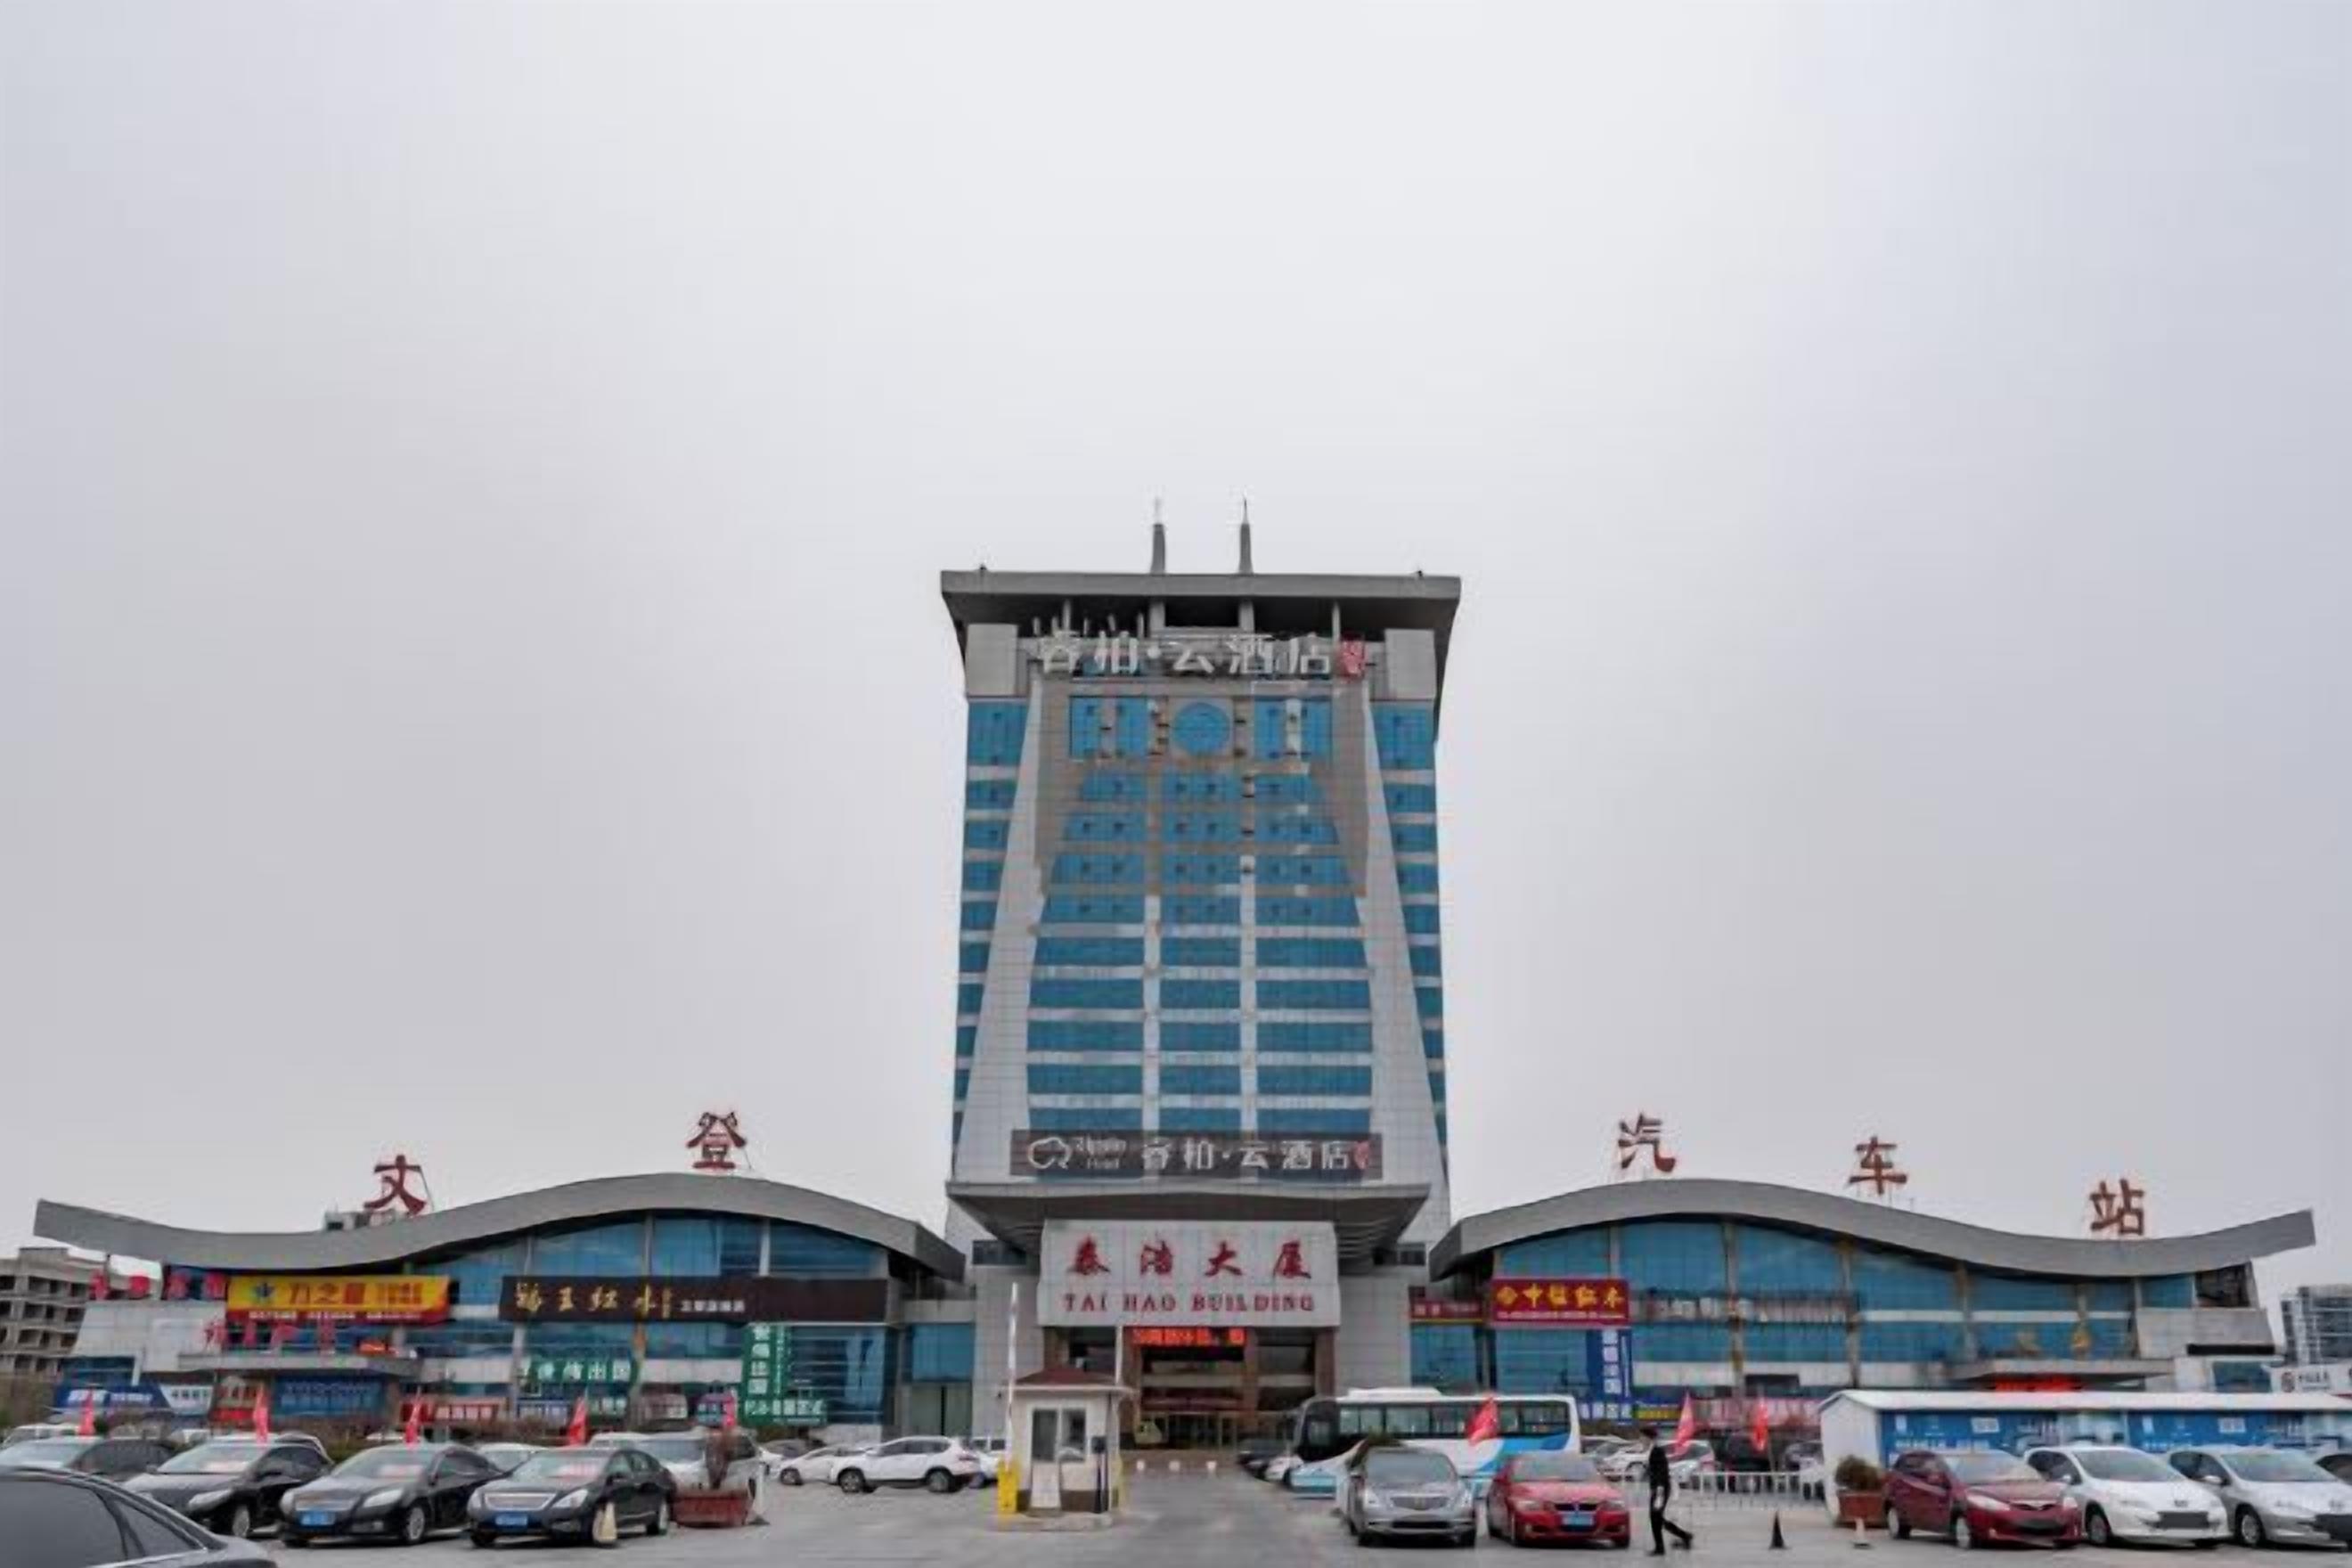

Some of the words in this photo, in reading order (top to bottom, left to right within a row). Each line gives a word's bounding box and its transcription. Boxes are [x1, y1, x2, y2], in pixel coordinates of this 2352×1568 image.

[364, 1155, 429, 1214] 文
[687, 1110, 747, 1169] 登
[1617, 1113, 1677, 1172] 汽
[1849, 1136, 1908, 1195] 车
[2089, 1179, 2146, 1237] 站
[1065, 1293, 1107, 1312] TAI
[1123, 1293, 1177, 1312] HAO
[1190, 1293, 1316, 1312] BUILDING
